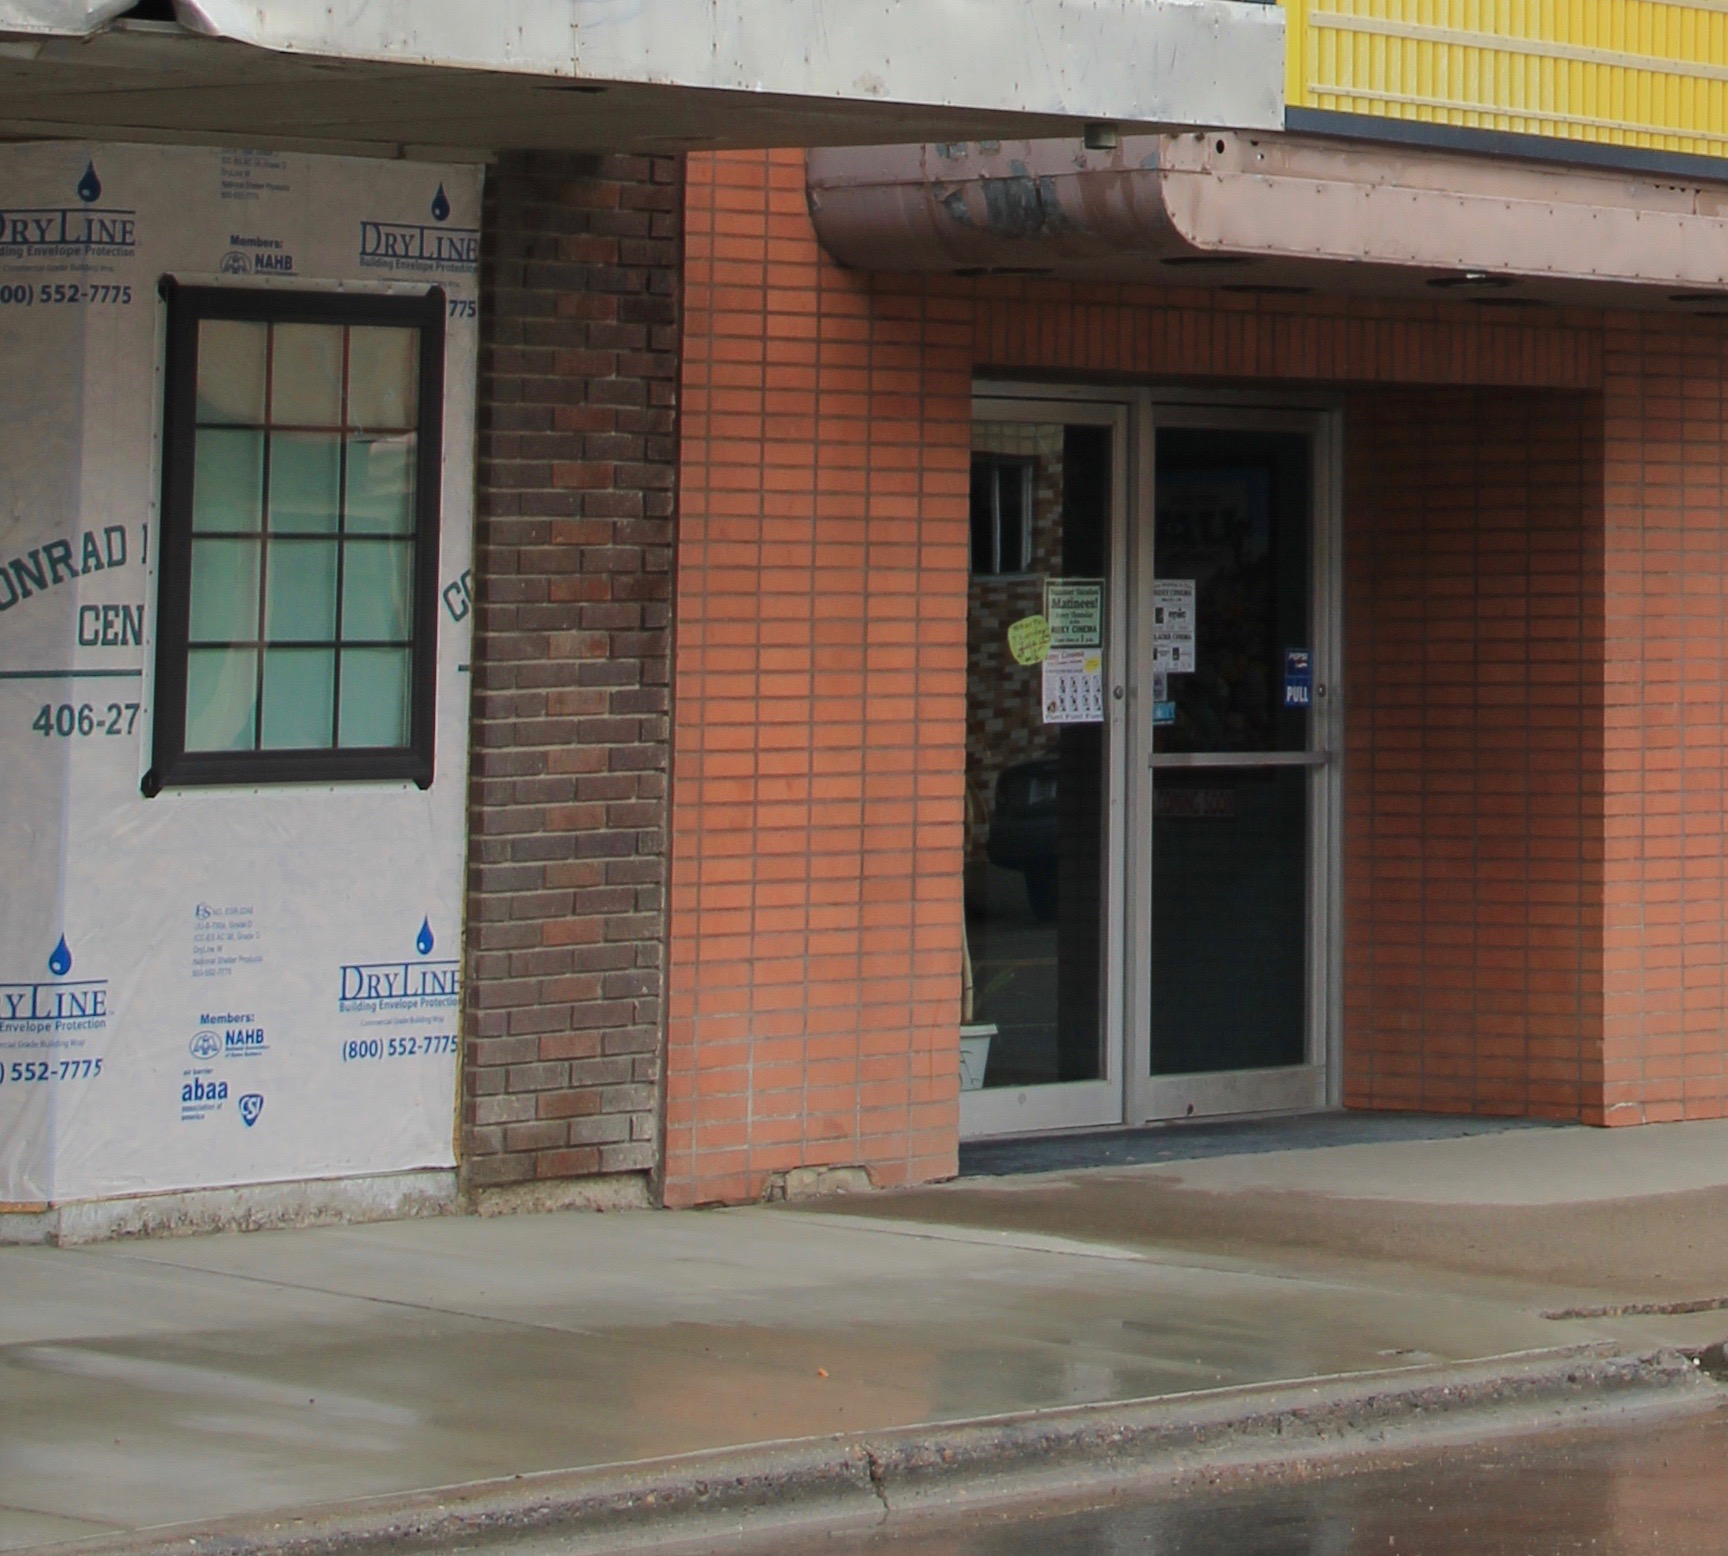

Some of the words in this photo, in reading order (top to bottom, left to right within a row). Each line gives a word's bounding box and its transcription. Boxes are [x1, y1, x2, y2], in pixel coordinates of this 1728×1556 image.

[230, 234, 283, 249] Members:
[27, 245, 80, 258] Envelope
[84, 246, 135, 257] Protection
[255, 254, 293, 270] NAHB
[360, 257, 393, 270] Building
[40, 284, 132, 305] 552-7775
[0, 524, 128, 612] ONRAD
[78, 604, 146, 646] CEN
[1286, 685, 1309, 703] PULL
[32, 702, 141, 737] 406-27
[340, 999, 377, 1013] Building
[379, 997, 418, 1011] Envelope
[0, 1020, 51, 1034] Envelope
[55, 1018, 106, 1031] Protection
[200, 1012, 255, 1025] Members:
[225, 1029, 265, 1046] NAHB
[343, 1037, 384, 1062] (800)
[388, 1034, 458, 1057] 552-7775
[11, 1058, 103, 1082] 552-7775
[181, 1077, 229, 1102] abaa
